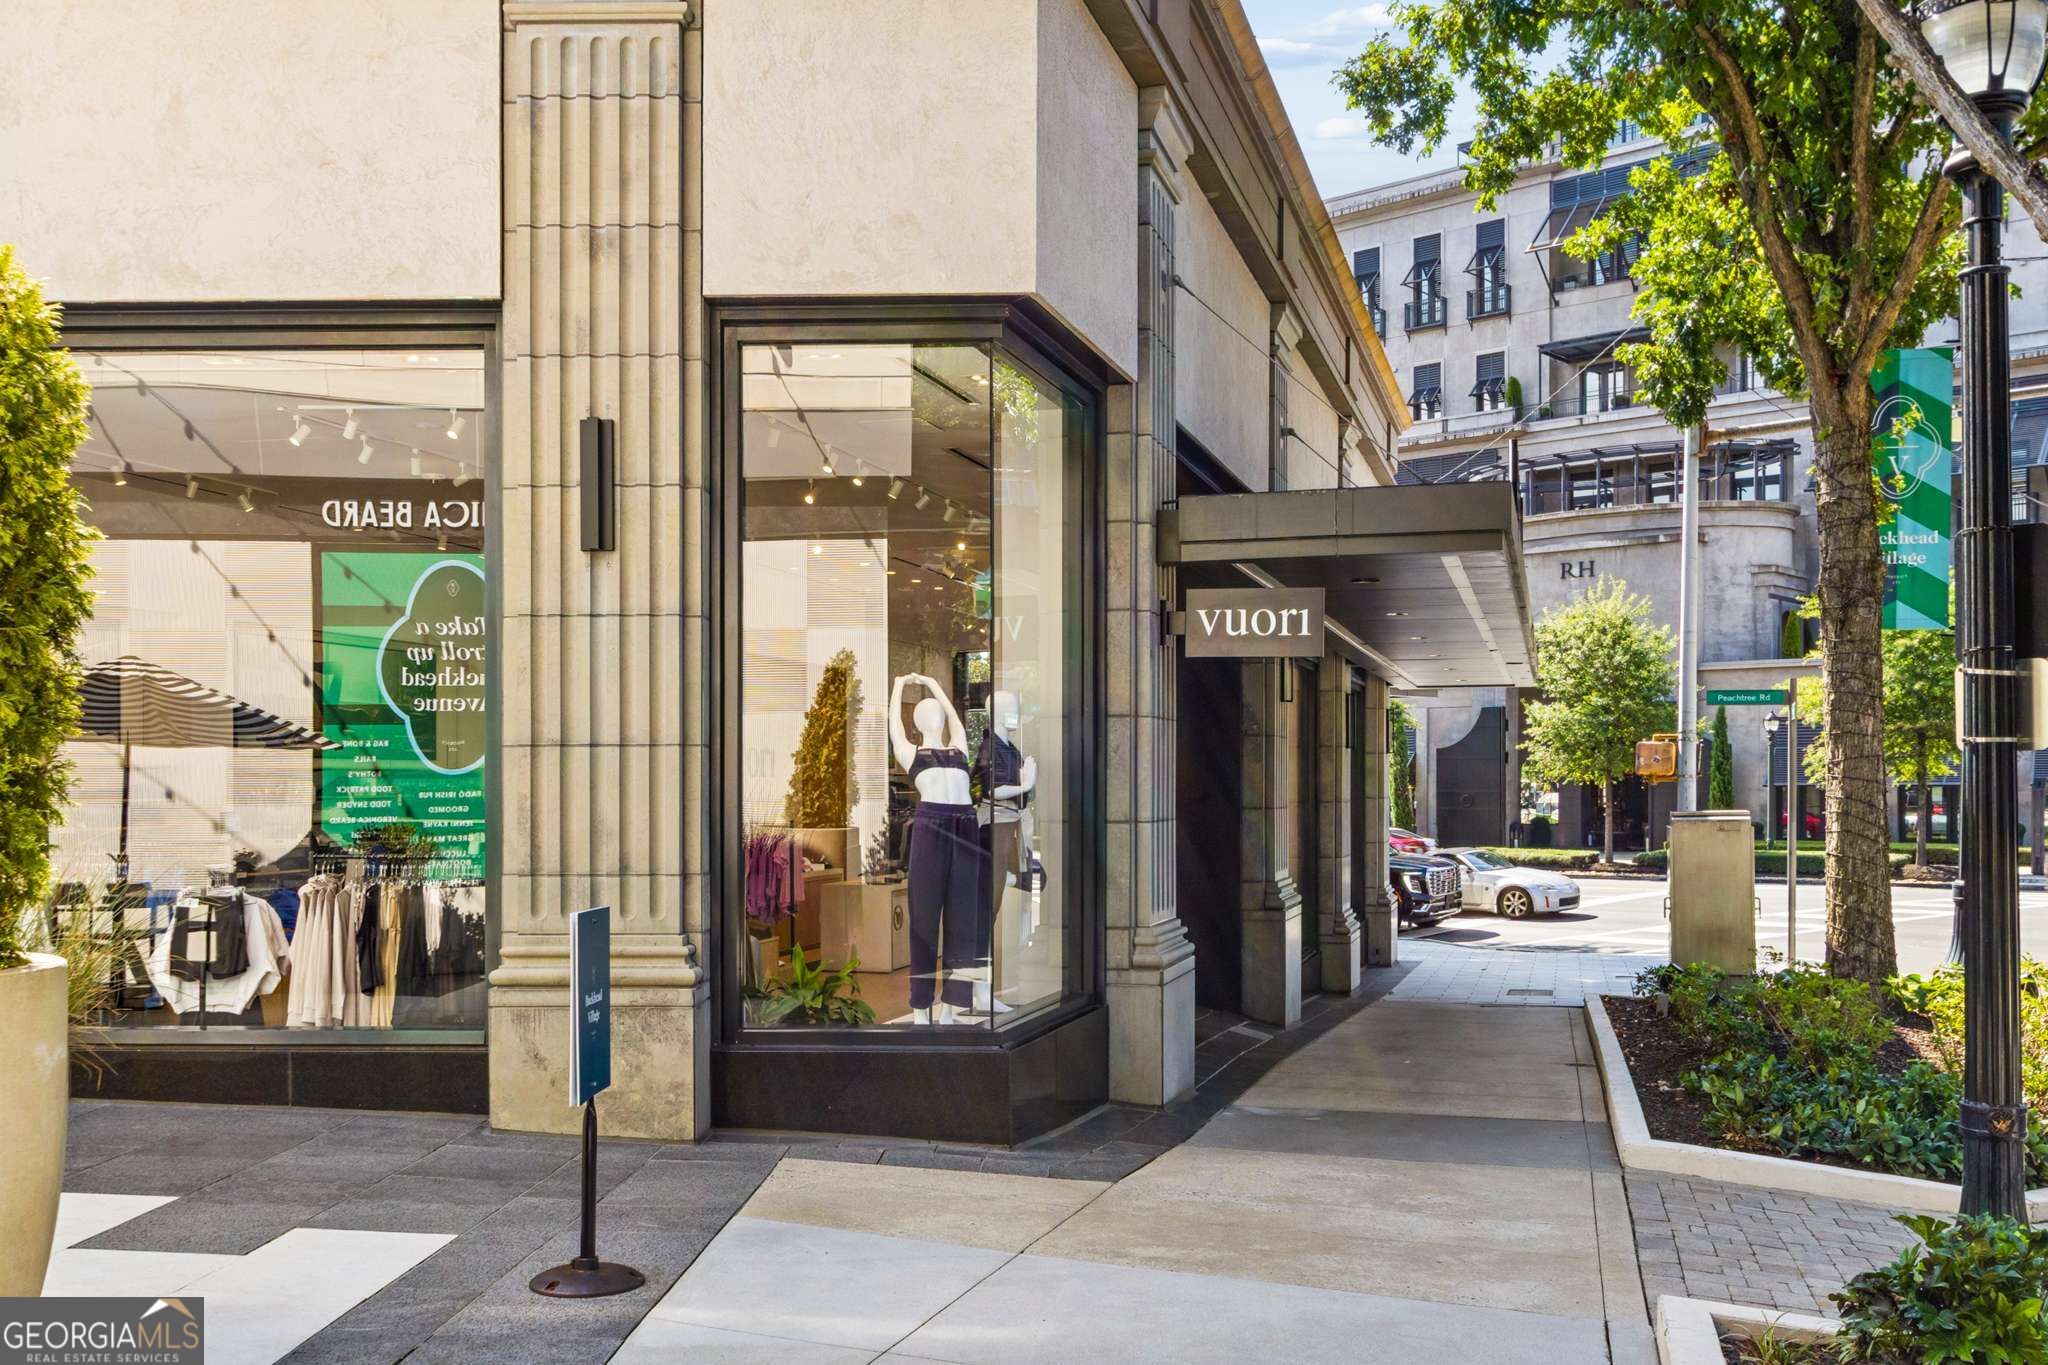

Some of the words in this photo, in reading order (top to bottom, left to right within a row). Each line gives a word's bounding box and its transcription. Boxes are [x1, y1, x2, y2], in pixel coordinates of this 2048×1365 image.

[1879, 530, 1939, 545] ckhead
[1881, 550, 1927, 568] illage
[1560, 560, 1595, 580] RH
[1196, 608, 1312, 637] vuori
[1717, 693, 1757, 702] Peachtree
[1759, 693, 1772, 702] Rd
